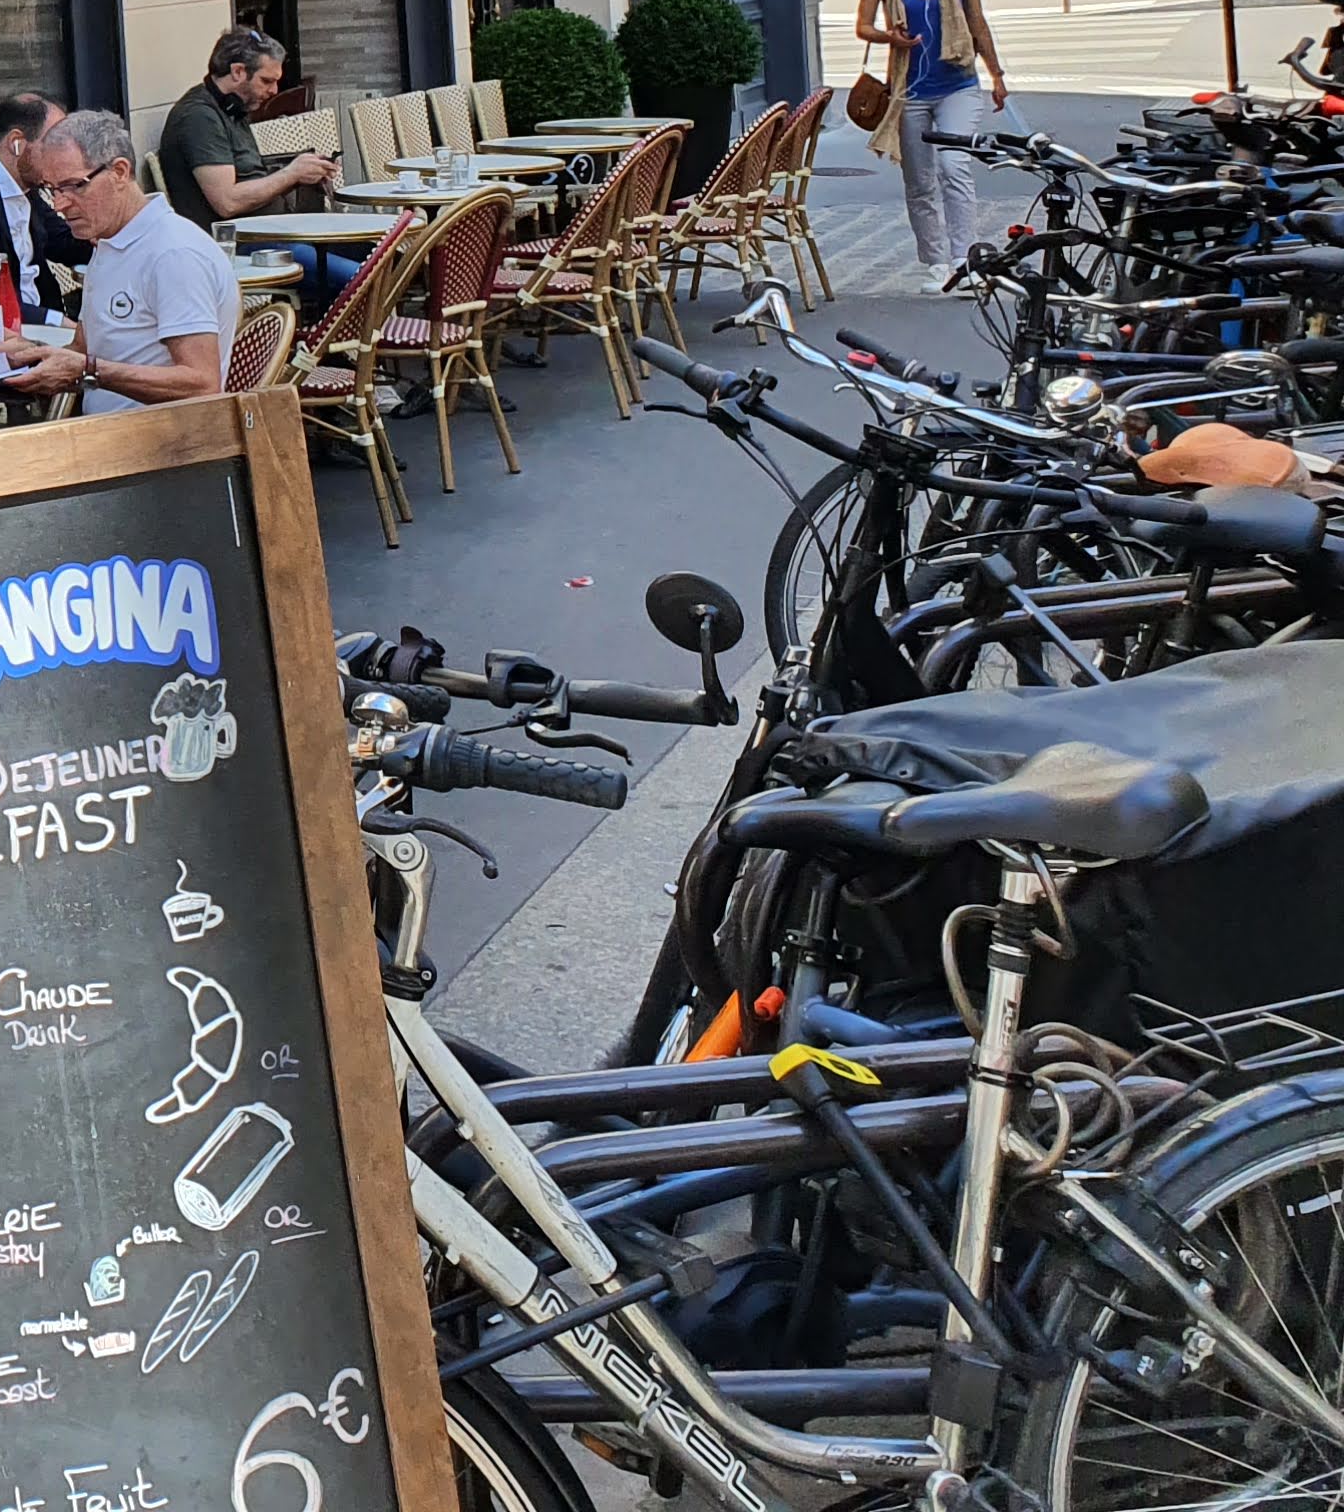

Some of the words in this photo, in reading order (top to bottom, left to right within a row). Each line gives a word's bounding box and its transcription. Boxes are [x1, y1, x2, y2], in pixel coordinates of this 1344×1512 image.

[260, 1044, 300, 1071] OR
[262, 1204, 313, 1231] OR
[540, 1287, 767, 1512] NICKEL
